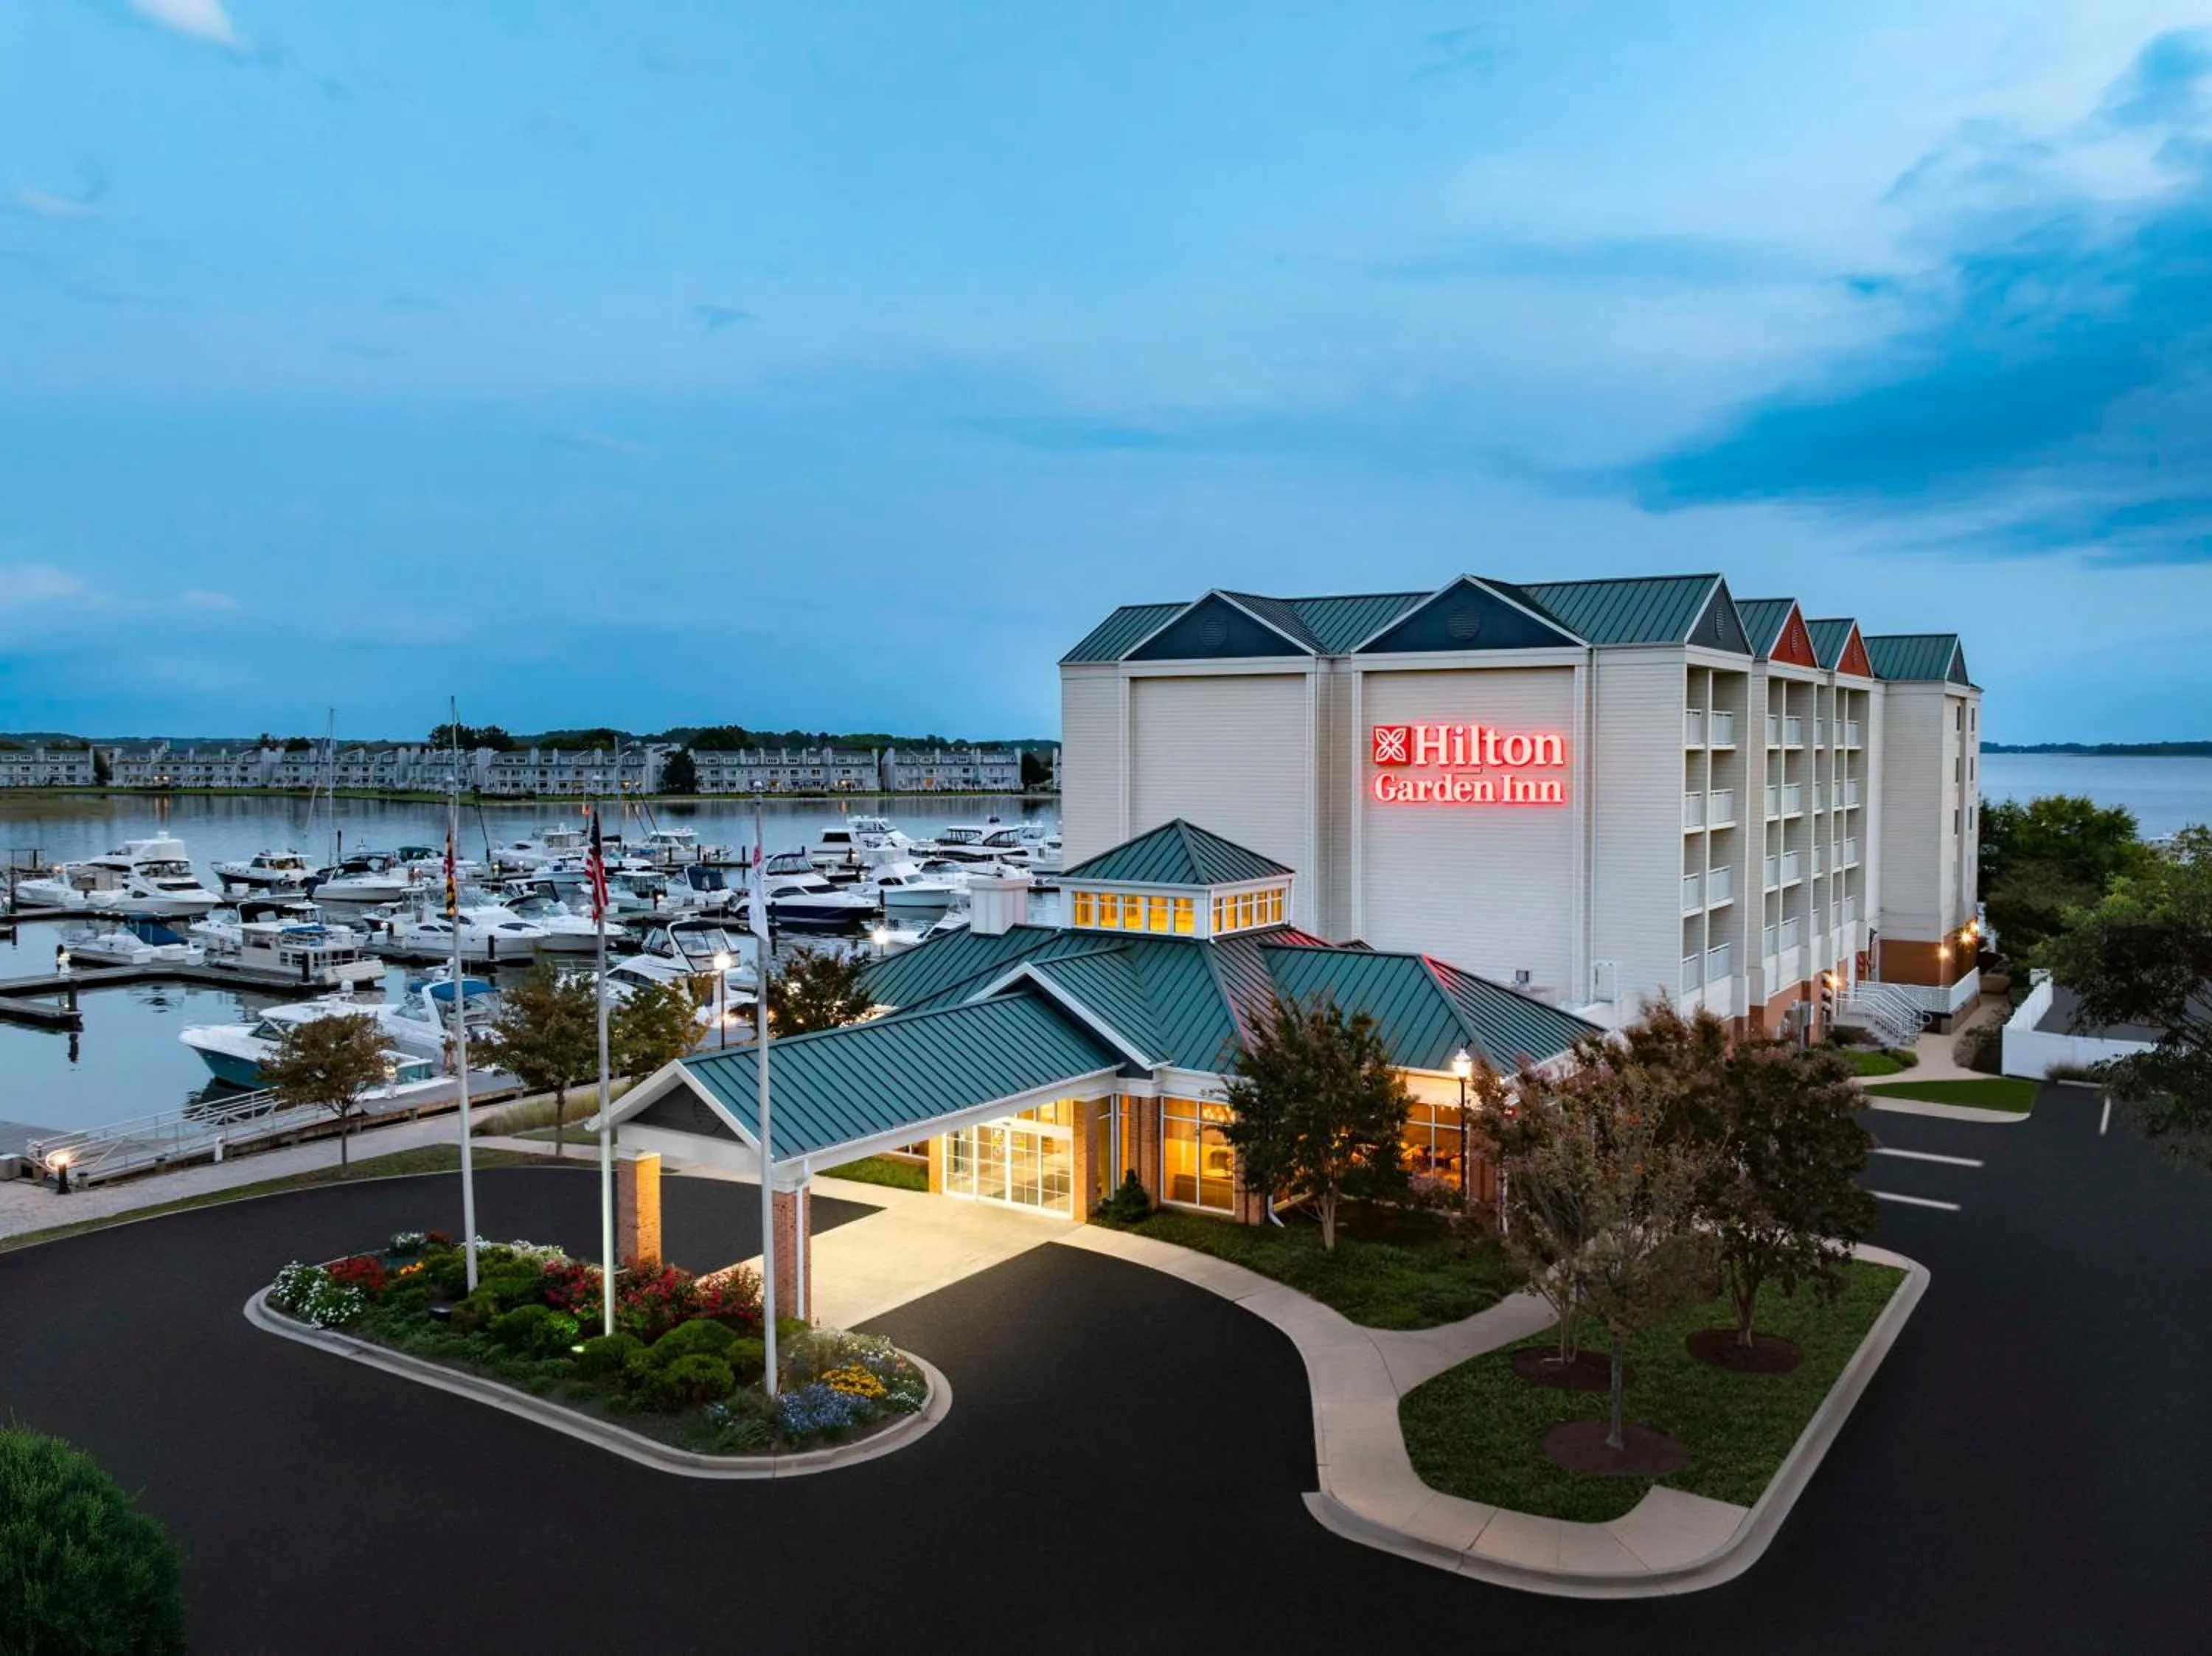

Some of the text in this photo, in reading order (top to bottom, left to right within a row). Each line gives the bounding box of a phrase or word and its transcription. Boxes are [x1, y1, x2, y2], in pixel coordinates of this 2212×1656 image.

[1413, 724, 1564, 766] Hilton
[1374, 773, 1563, 803] Garden Inn
